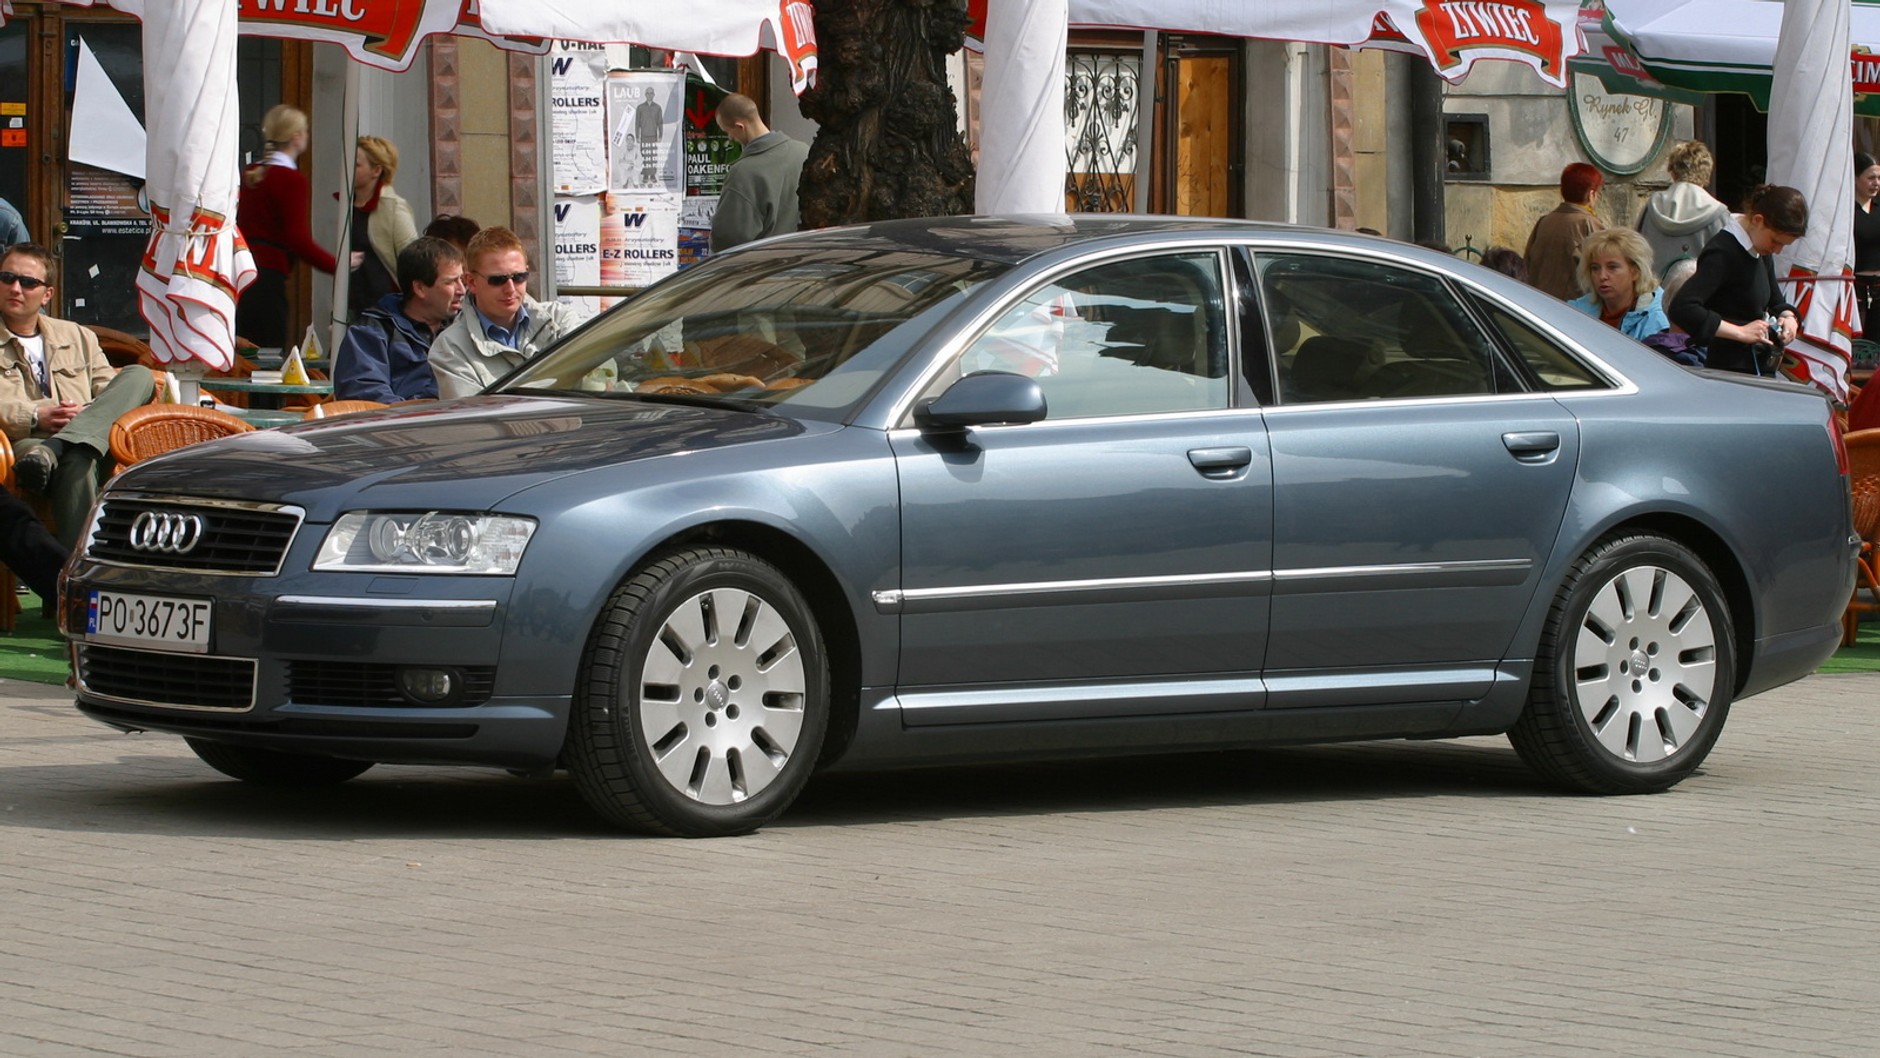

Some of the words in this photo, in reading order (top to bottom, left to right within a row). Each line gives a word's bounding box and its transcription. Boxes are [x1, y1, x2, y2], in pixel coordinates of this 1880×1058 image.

[614, 87, 641, 99] LAUB
[1583, 95, 1631, 119] Rynek
[1614, 127, 1629, 143] 47
[687, 153, 711, 164] PAUL
[624, 213, 646, 227] W
[555, 244, 597, 254] OLLERS
[603, 249, 621, 259] E-Z
[624, 249, 675, 260] ROLLERS
[99, 595, 127, 634] PO
[134, 599, 208, 641] 3673F
